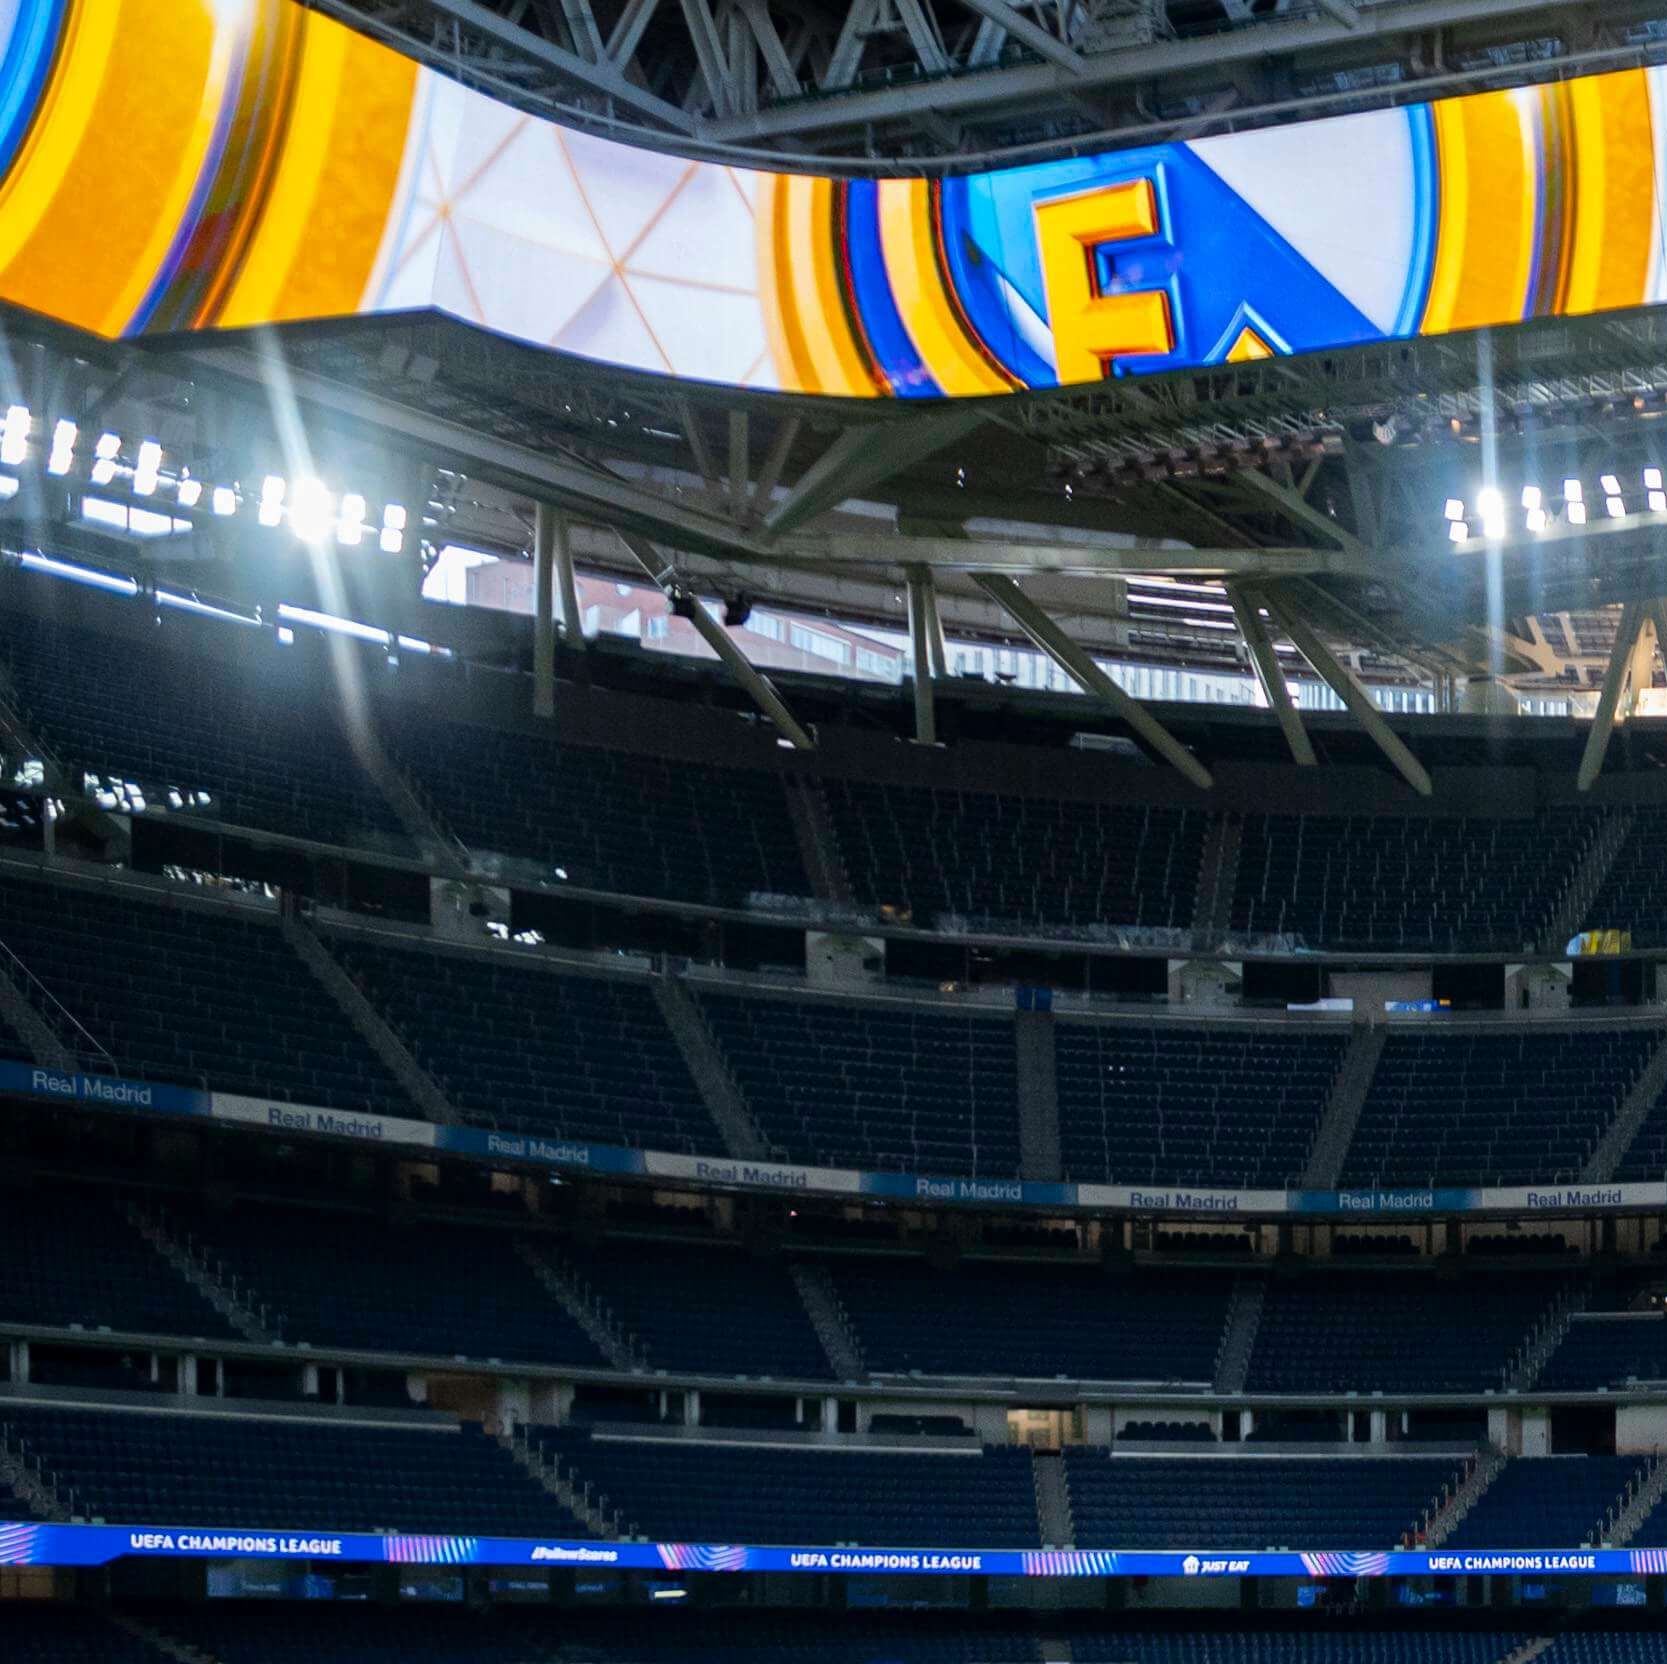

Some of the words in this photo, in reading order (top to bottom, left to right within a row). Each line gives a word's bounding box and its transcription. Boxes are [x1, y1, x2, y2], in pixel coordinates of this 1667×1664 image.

[32, 1070, 77, 1094] Real
[83, 1077, 152, 1105] Madrid
[268, 1107, 311, 1128] Real
[317, 1115, 381, 1137] Madrid
[488, 1134, 525, 1156] Real
[529, 1141, 589, 1163] Madrid
[697, 1162, 737, 1181] Real
[743, 1167, 807, 1188] Madrid
[916, 1179, 955, 1197] Real
[960, 1181, 1022, 1200] Madrid
[1527, 1192, 1561, 1207] Real
[1567, 1190, 1621, 1206] Madrid
[1130, 1191, 1170, 1209] Real
[1175, 1192, 1238, 1210] Madrid
[1339, 1192, 1374, 1209] Real
[1380, 1192, 1433, 1208] Madrid
[130, 1534, 175, 1549] UEFA
[177, 1535, 277, 1553] CHAMPIONS
[279, 1538, 342, 1555] LEAGUE
[790, 1553, 828, 1567] UEFA
[830, 1554, 920, 1569] CHAMPIONS
[922, 1555, 981, 1570] LEAGUE
[1428, 1557, 1461, 1570] UEFA
[1464, 1556, 1543, 1570] CHAMPIONS
[1544, 1556, 1596, 1569] LEAGUE
